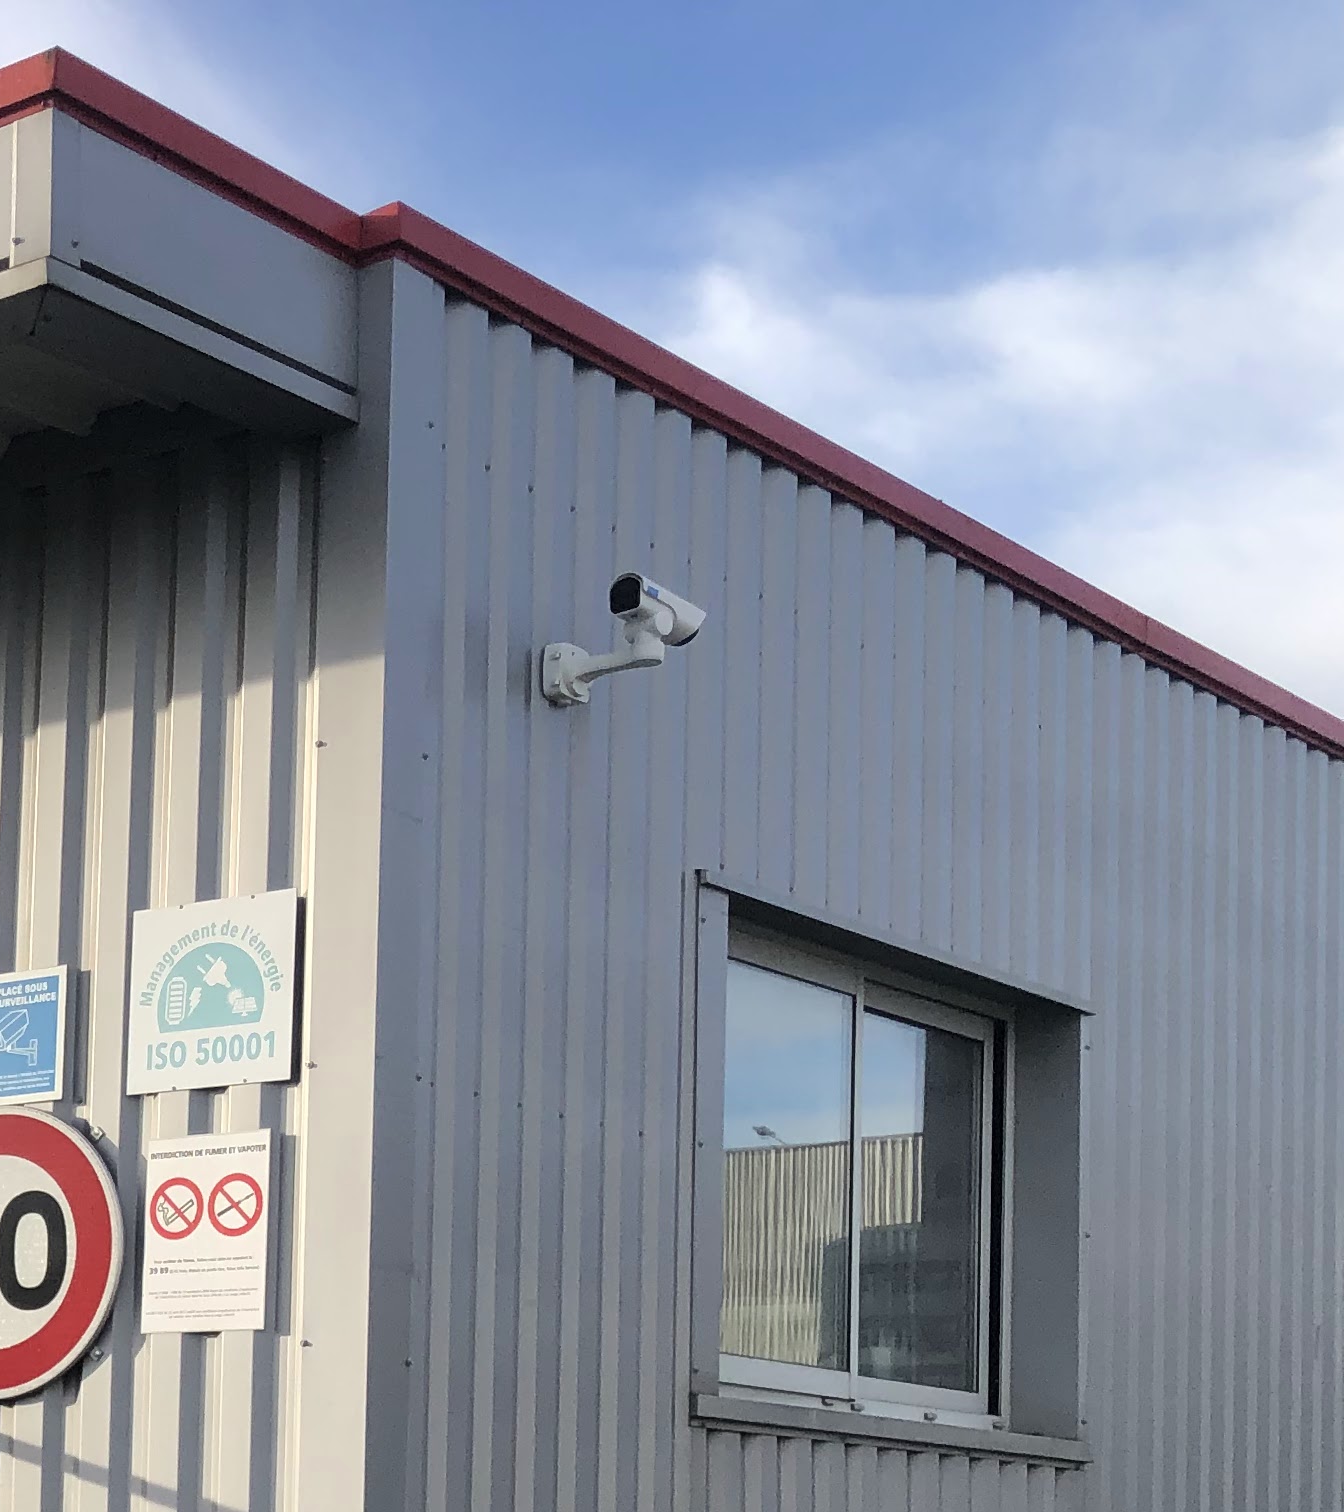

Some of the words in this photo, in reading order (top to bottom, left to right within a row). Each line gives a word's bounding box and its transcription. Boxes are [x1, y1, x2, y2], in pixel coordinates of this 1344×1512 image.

[139, 921, 217, 1007] Management
[220, 920, 239, 938] de
[241, 925, 284, 992] l'énergie
[24, 981, 48, 993] SOUS
[146, 1040, 187, 1070] ISO
[195, 1030, 275, 1066] 50001
[150, 1149, 193, 1160] INTERDICTION
[194, 1149, 204, 1157] DE
[205, 1147, 227, 1156] FUMER
[237, 1144, 266, 1153] VAPOTER
